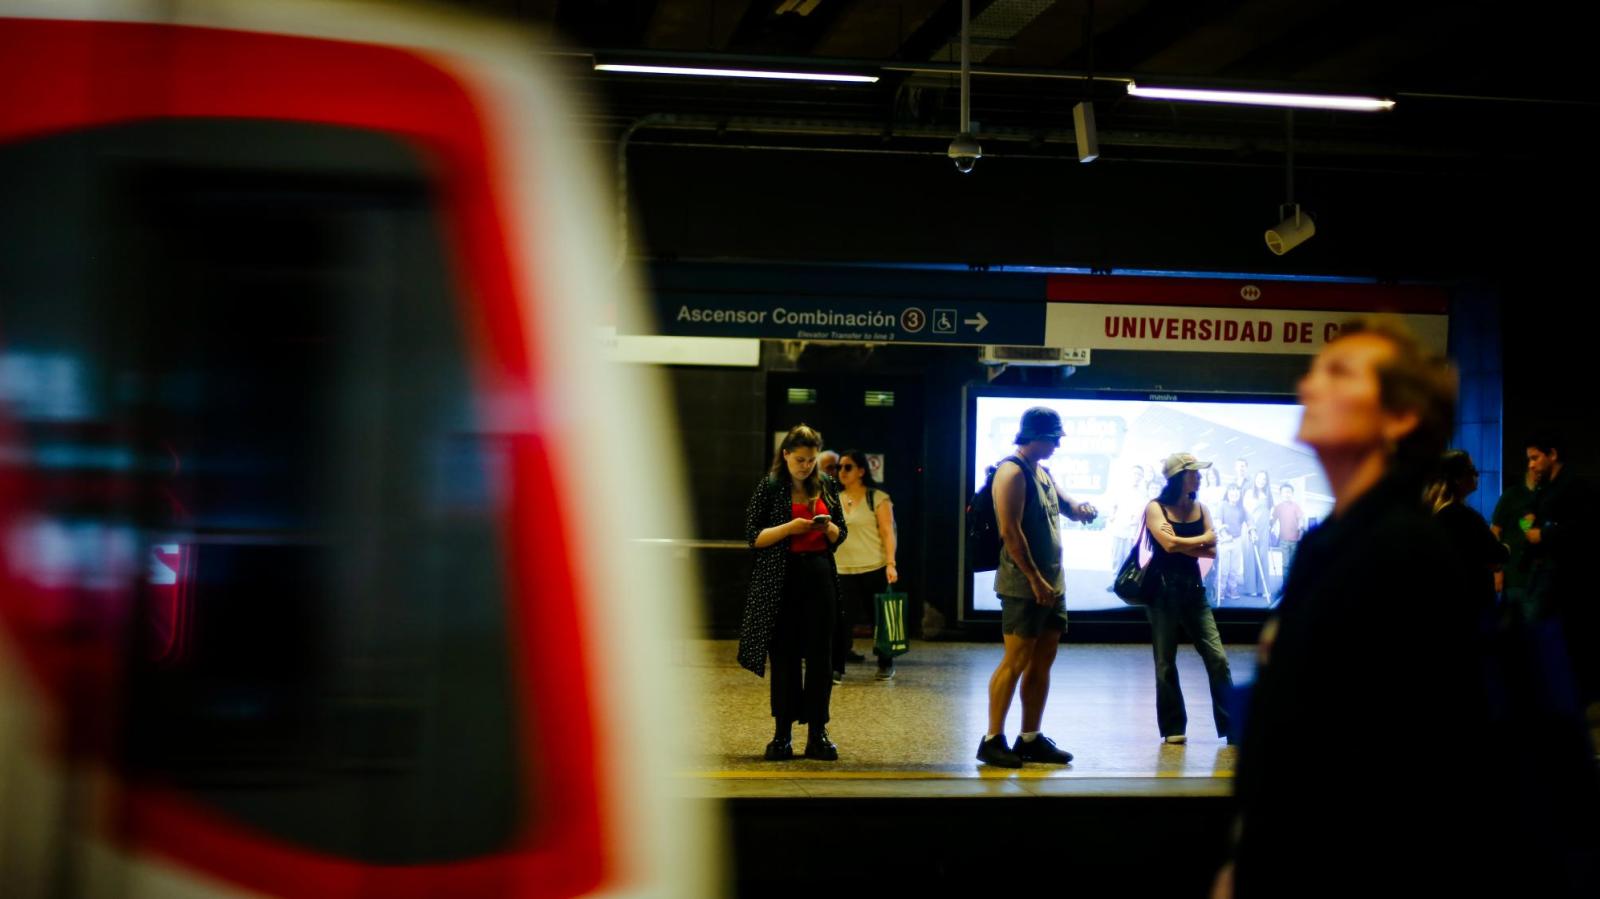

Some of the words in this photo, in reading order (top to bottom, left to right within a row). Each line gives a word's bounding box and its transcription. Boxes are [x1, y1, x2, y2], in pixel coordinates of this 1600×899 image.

[677, 305, 767, 323] Ascensor
[772, 307, 895, 327] Combinación
[797, 330, 829, 338] Elevator
[831, 331, 862, 339] Transfer
[863, 332, 872, 340] to
[1104, 315, 1273, 343] UNIVERSIDAD
[1283, 321, 1313, 344] DE
